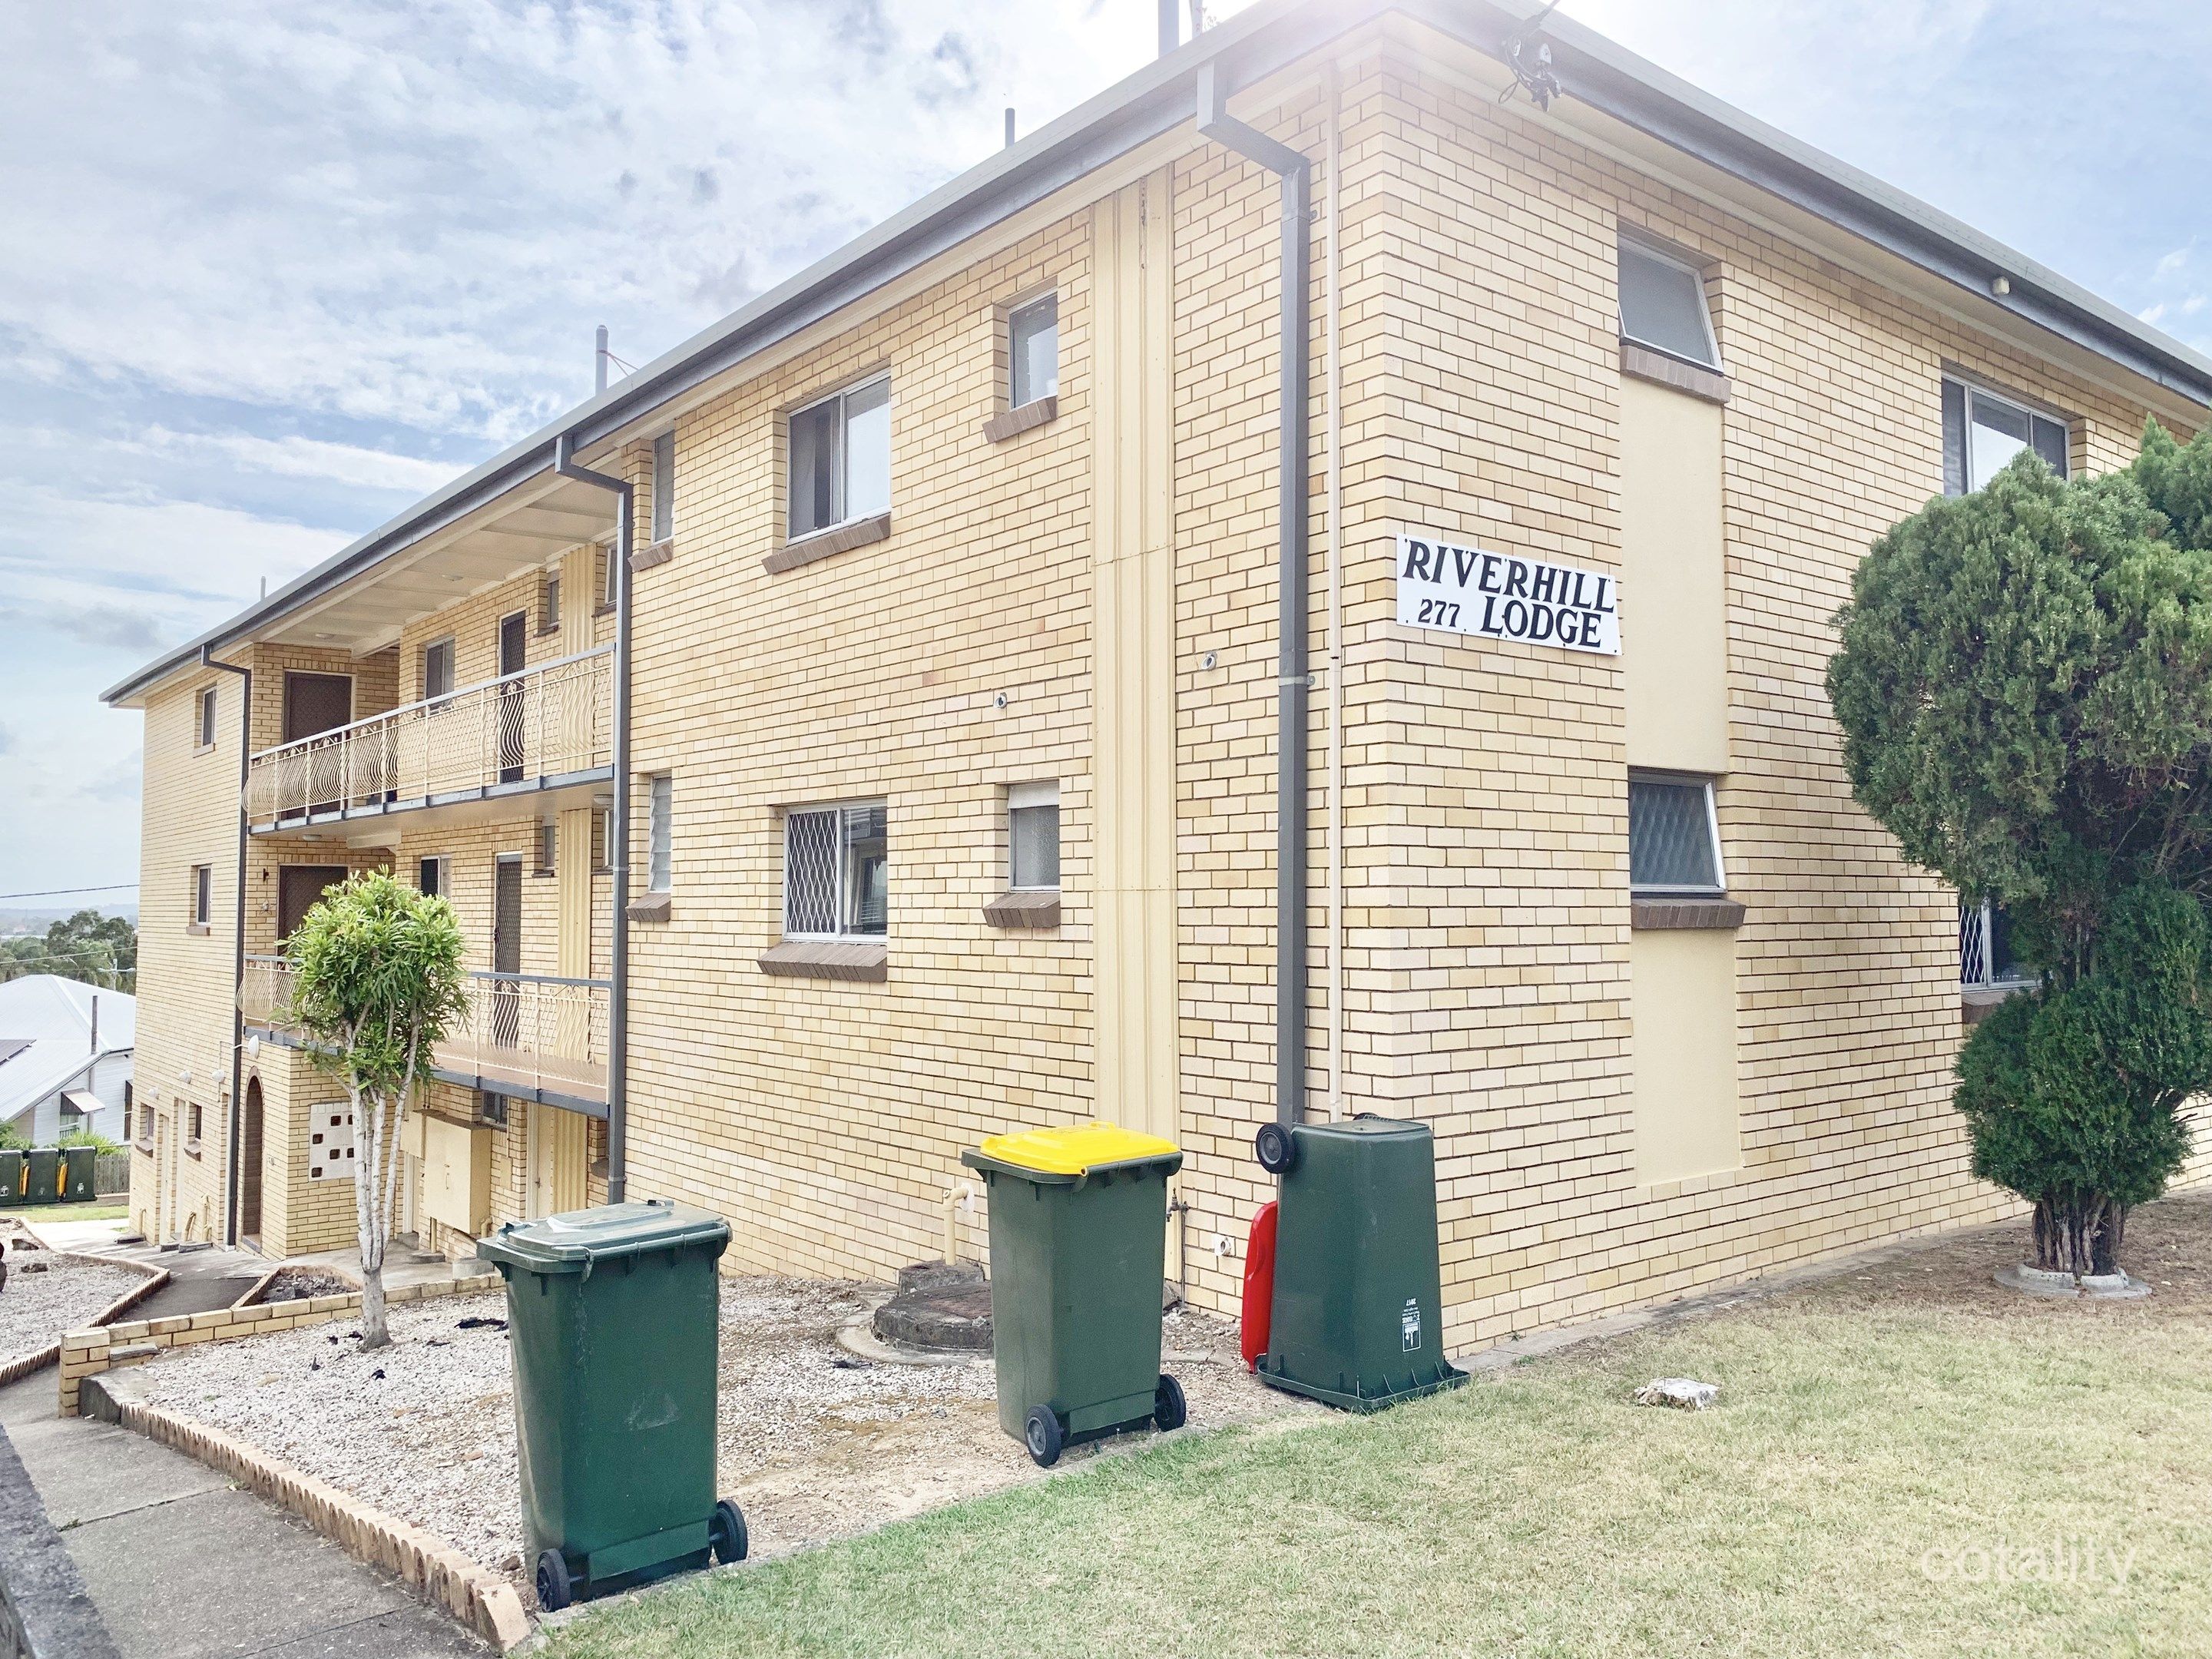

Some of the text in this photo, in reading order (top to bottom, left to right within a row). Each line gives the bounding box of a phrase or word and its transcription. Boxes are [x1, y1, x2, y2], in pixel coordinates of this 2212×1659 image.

[1402, 541, 1614, 613] RIVERHILL
[1418, 598, 1461, 628] 277
[1480, 596, 1601, 648] LODGE
